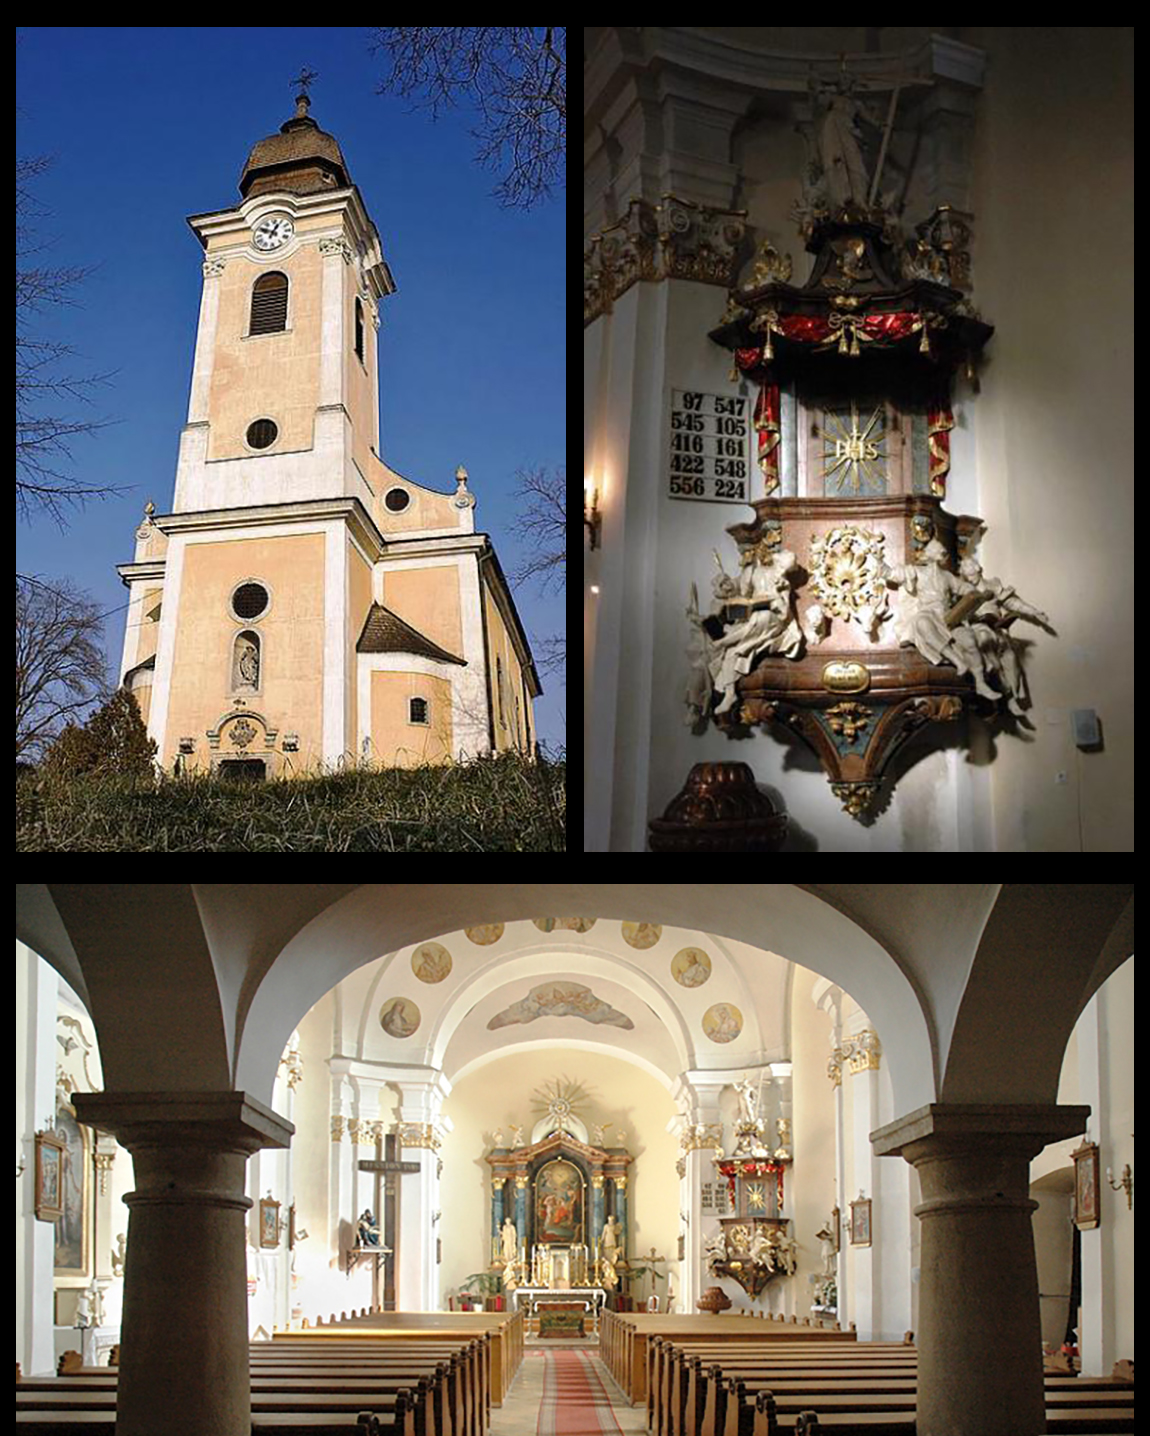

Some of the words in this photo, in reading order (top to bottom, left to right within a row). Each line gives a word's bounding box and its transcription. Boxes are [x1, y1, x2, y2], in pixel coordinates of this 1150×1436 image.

[683, 392, 703, 411] 97
[714, 398, 746, 416] 547
[671, 411, 705, 432] 545
[715, 417, 746, 436] 105
[671, 433, 704, 453] 416
[715, 439, 745, 458] 161
[670, 454, 705, 474] 422
[714, 459, 746, 479] 548
[670, 475, 705, 496] 556
[714, 479, 745, 499] 224
